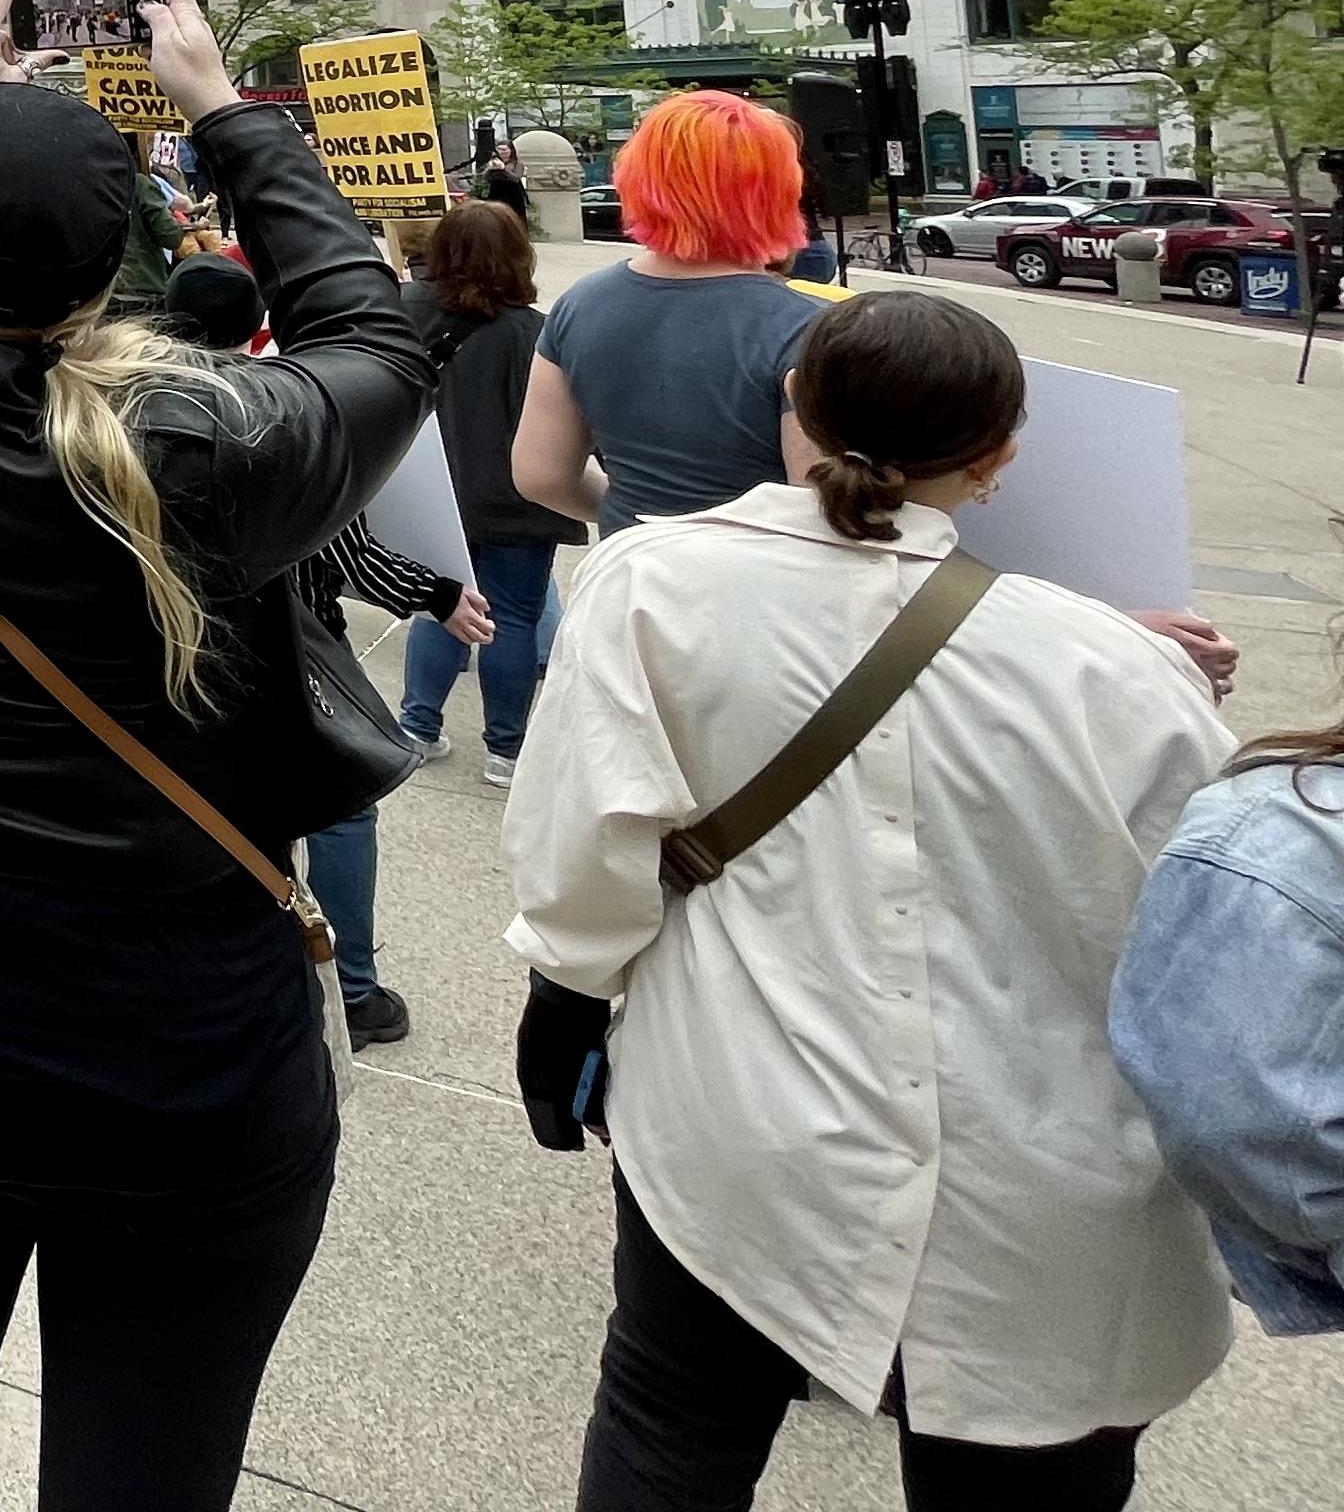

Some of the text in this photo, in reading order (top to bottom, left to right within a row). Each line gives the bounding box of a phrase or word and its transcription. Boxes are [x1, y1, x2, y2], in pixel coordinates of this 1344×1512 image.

[86, 61, 150, 71] REPRODUC
[304, 51, 419, 83] LEGALIZE
[99, 96, 176, 117] NOW!
[314, 87, 425, 115] ABORTION
[323, 132, 434, 157] ONCE AND
[333, 162, 435, 186] FOR ALL!
[1062, 237, 1115, 259] NEW
[1247, 267, 1289, 299] Indy
